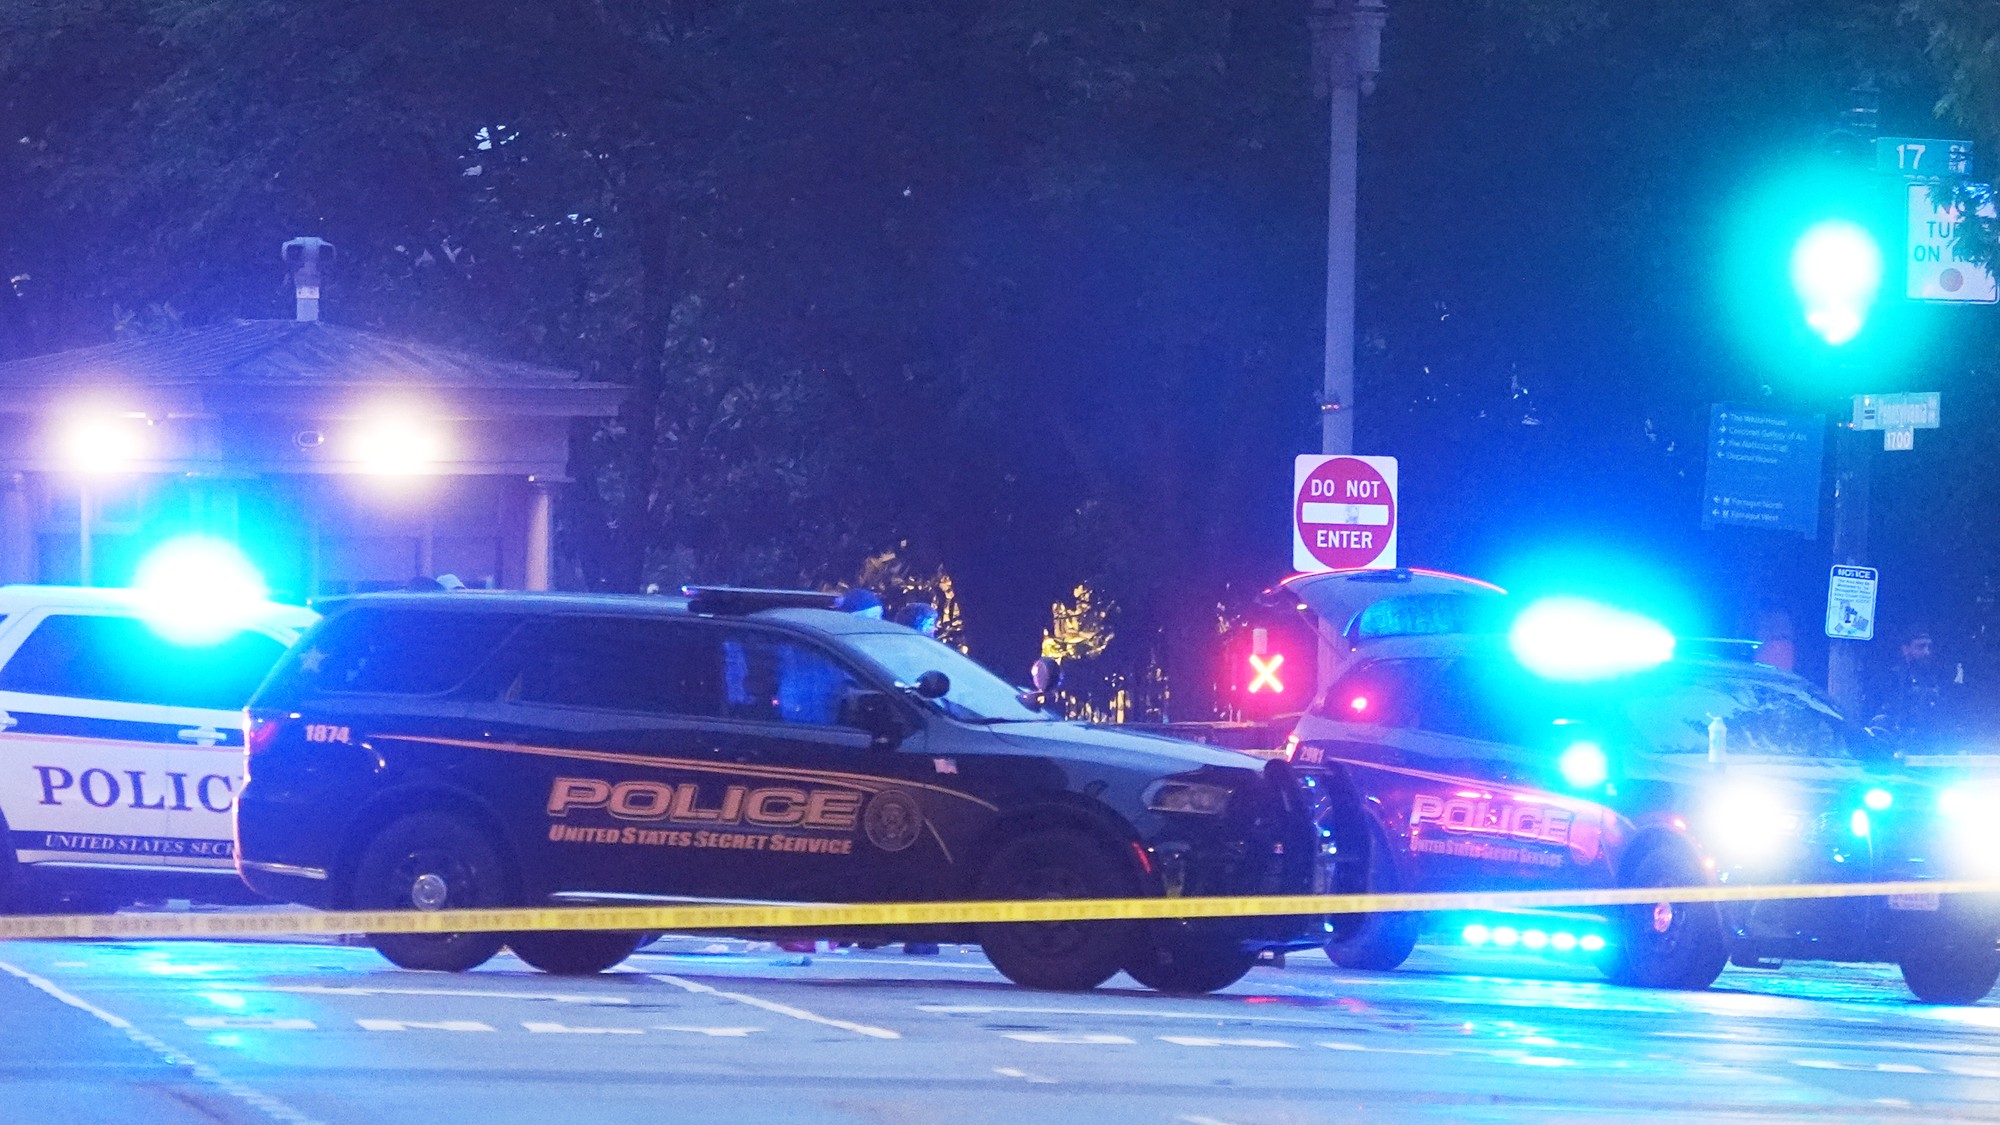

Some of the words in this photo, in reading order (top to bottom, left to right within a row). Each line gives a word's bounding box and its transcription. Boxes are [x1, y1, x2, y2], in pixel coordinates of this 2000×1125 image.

[1896, 144, 1926, 170] 17
[1914, 245, 1940, 263] ON
[1886, 431, 1911, 449] 1700
[1311, 479, 1335, 497] DO
[1346, 480, 1381, 498] NOT
[1316, 530, 1373, 549] ENTER
[1837, 569, 1871, 579] NOTICE
[306, 724, 350, 744] 1874
[32, 765, 243, 814] POLIC
[547, 777, 862, 831] POLICE
[1410, 794, 1574, 845] POLICE
[45, 834, 115, 851] UNITED
[118, 838, 184, 855] STATES
[190, 841, 234, 857] SEC
[549, 824, 620, 844] UNITED
[622, 826, 692, 848] STATES
[693, 830, 768, 851] SECRET
[769, 833, 852, 855] SERVICE
